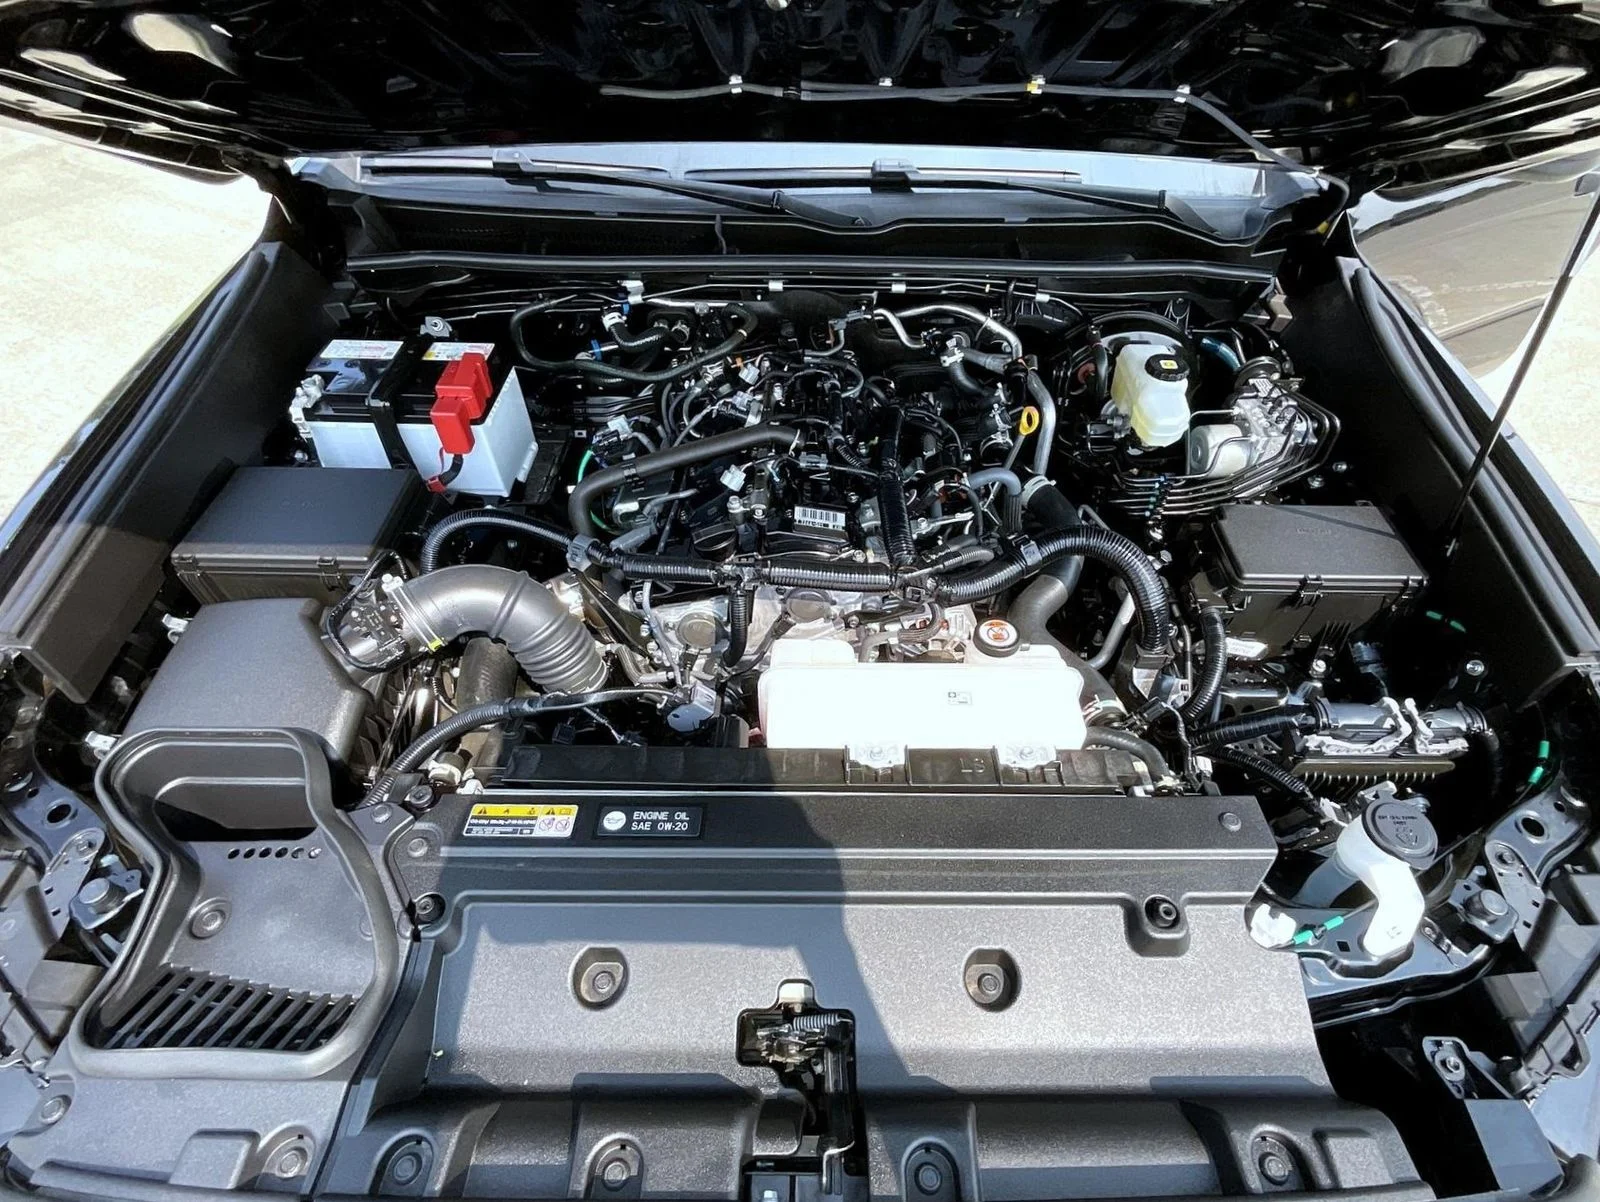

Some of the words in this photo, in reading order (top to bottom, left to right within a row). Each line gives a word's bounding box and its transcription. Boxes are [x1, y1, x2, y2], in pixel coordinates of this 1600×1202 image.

[632, 811, 669, 820] ENGINE
[674, 812, 690, 820] OIL
[631, 821, 652, 831] SAE
[657, 822, 689, 831] 0W-20
